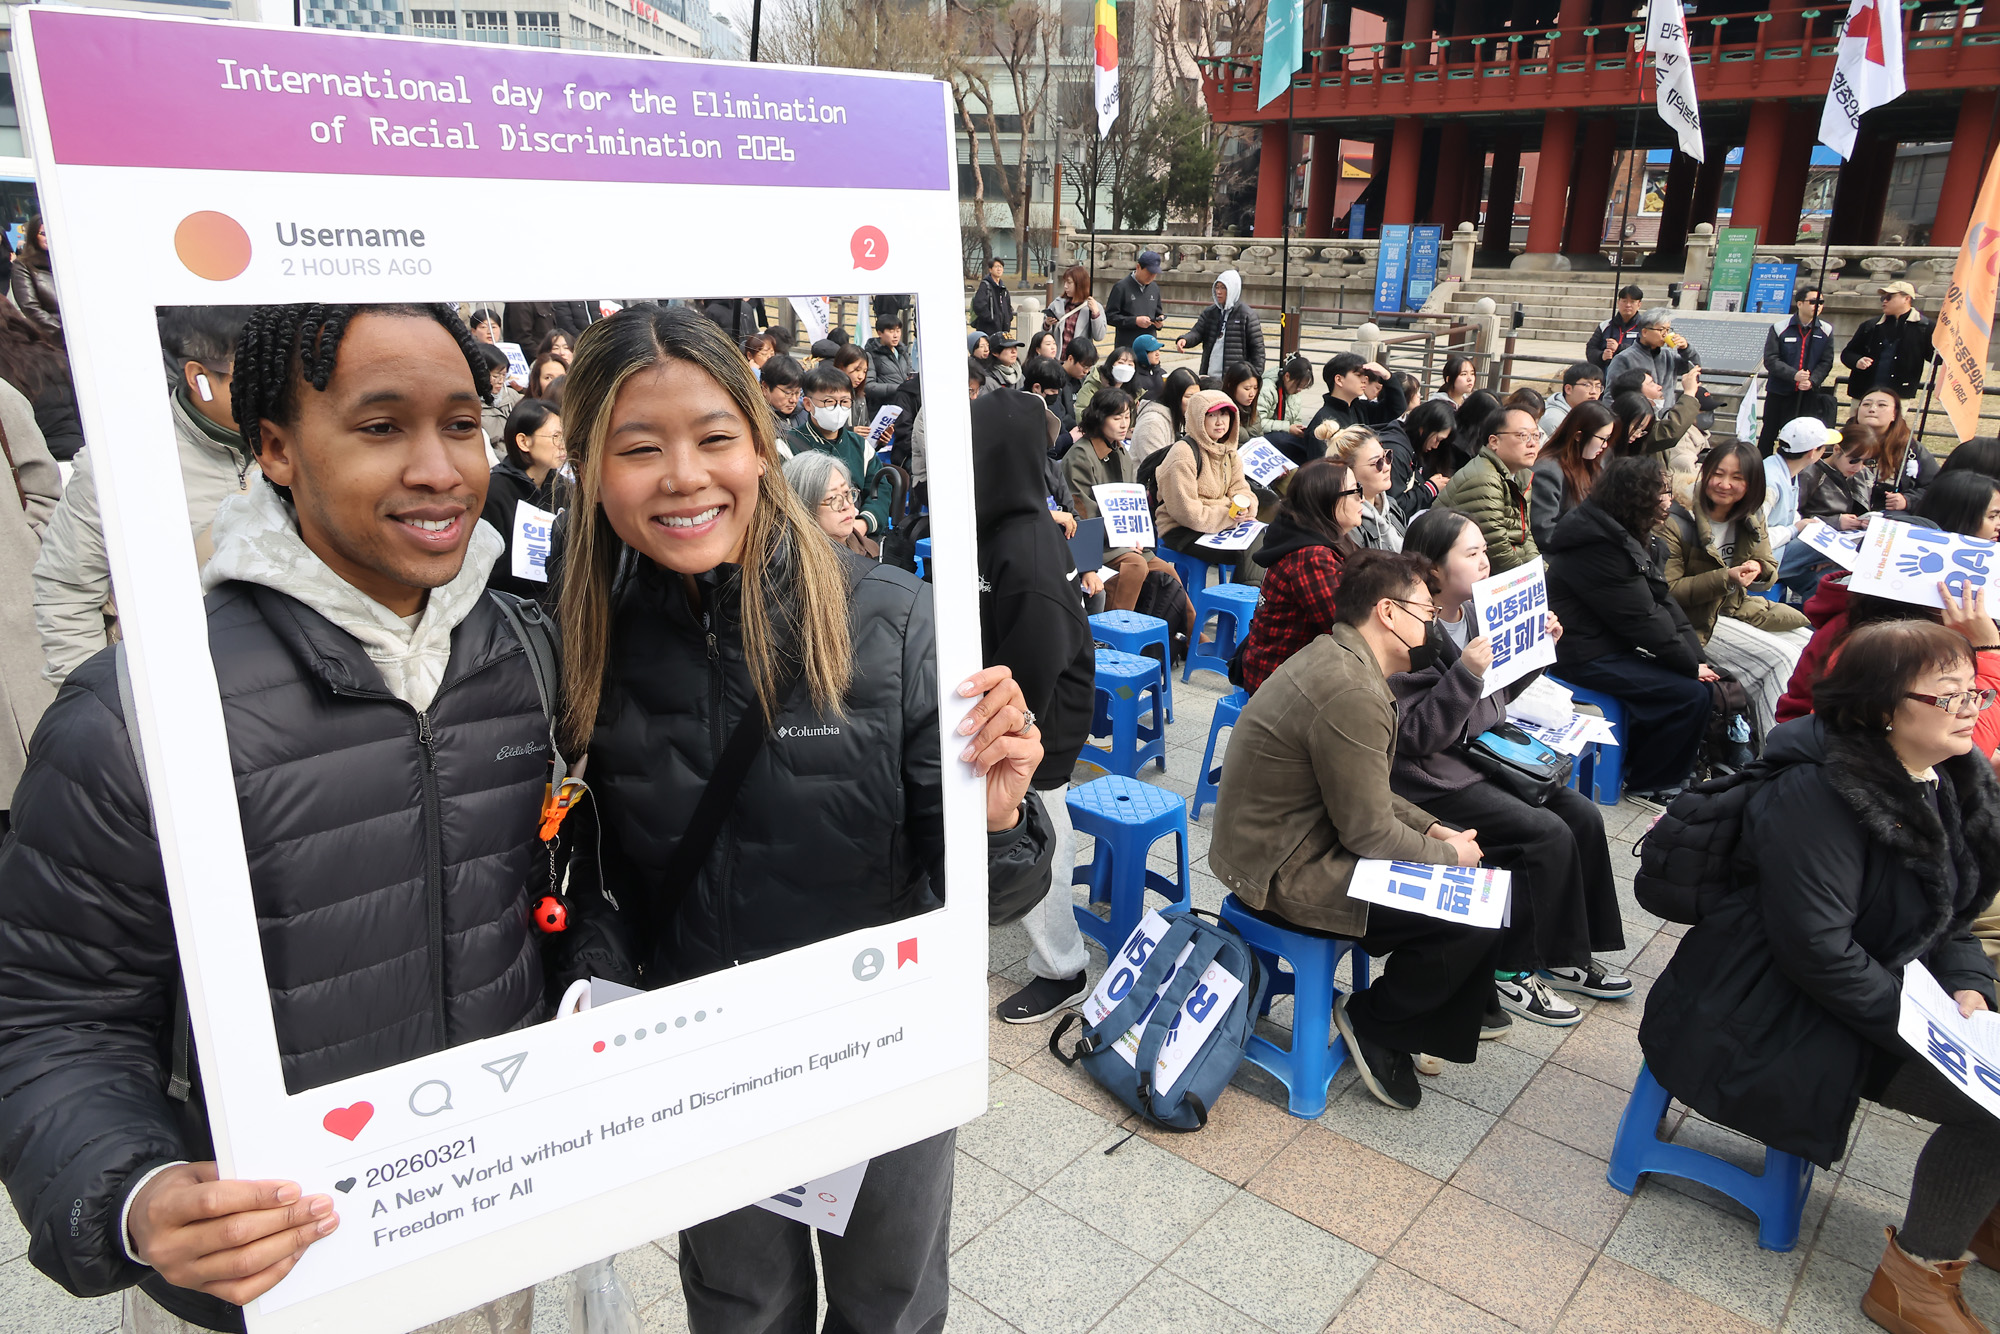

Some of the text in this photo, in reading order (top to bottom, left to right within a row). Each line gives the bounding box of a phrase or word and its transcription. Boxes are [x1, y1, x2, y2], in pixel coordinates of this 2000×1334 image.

[630, 0, 659, 24] YMCA
[217, 59, 847, 124] International day for the Elimination
[310, 115, 796, 162] of Racial Discrimination 2026
[275, 222, 426, 247] Username
[863, 238, 877, 258] 2
[281, 258, 432, 276] 2 HOURS AGO
[1253, 446, 1274, 460] NO
[1104, 498, 1148, 512] 인종차별
[1112, 515, 1150, 534] 철폐!
[1485, 580, 1546, 632] 인종차별
[1491, 613, 1545, 670] 철폐!
[788, 724, 840, 737] Columbia
[371, 1026, 904, 1219] A New World without Hate and Discrimination Equality and
[366, 1136, 477, 1188] 20260321
[70, 1198, 83, 1237] EB650
[373, 1177, 534, 1248] Freedom for All
